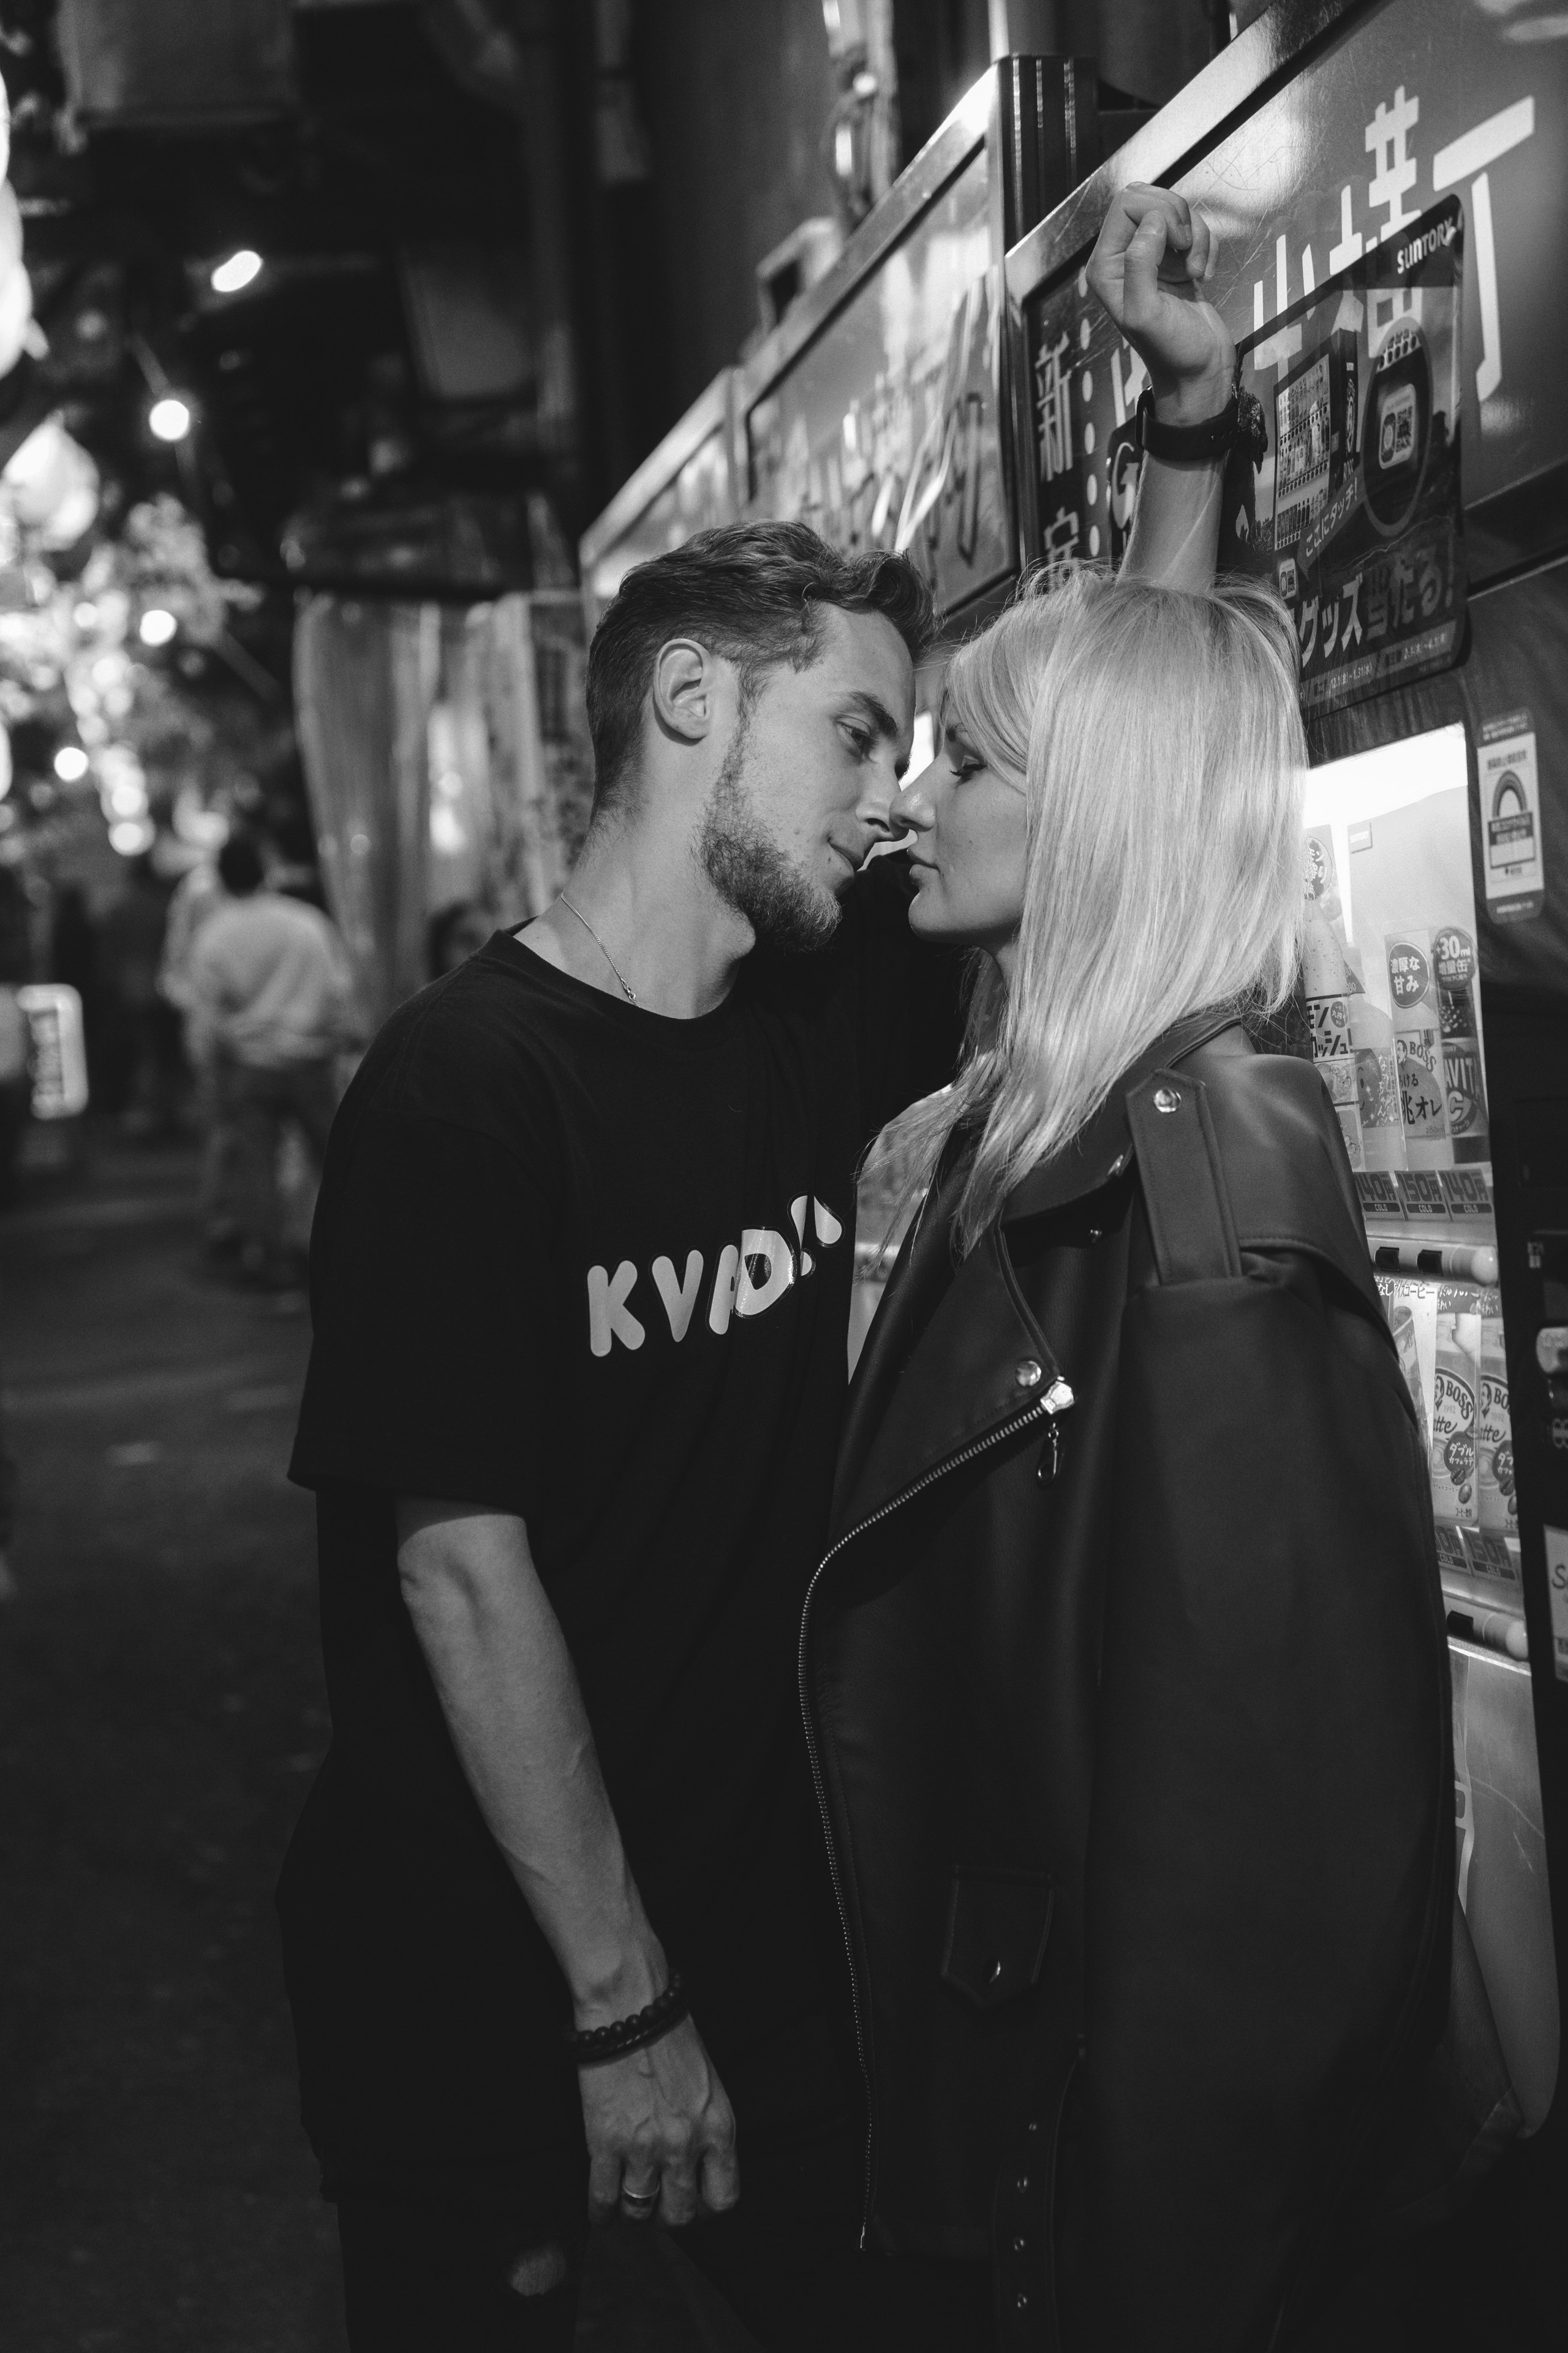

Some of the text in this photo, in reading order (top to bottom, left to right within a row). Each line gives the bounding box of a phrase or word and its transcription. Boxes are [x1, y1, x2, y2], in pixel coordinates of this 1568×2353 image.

[1390, 956, 1420, 974] 濃厚な
[1393, 975, 1419, 995] 甘み
[1409, 1041, 1436, 1072] BOSS
[1418, 1204, 1433, 1213] COLD
[1463, 1204, 1479, 1213] COLD
[1446, 1380, 1473, 1420] BOSS
[1494, 1388, 1510, 1410] BO
[1450, 1441, 1474, 1456] ダブル
[1439, 1554, 1453, 1565] COLD
